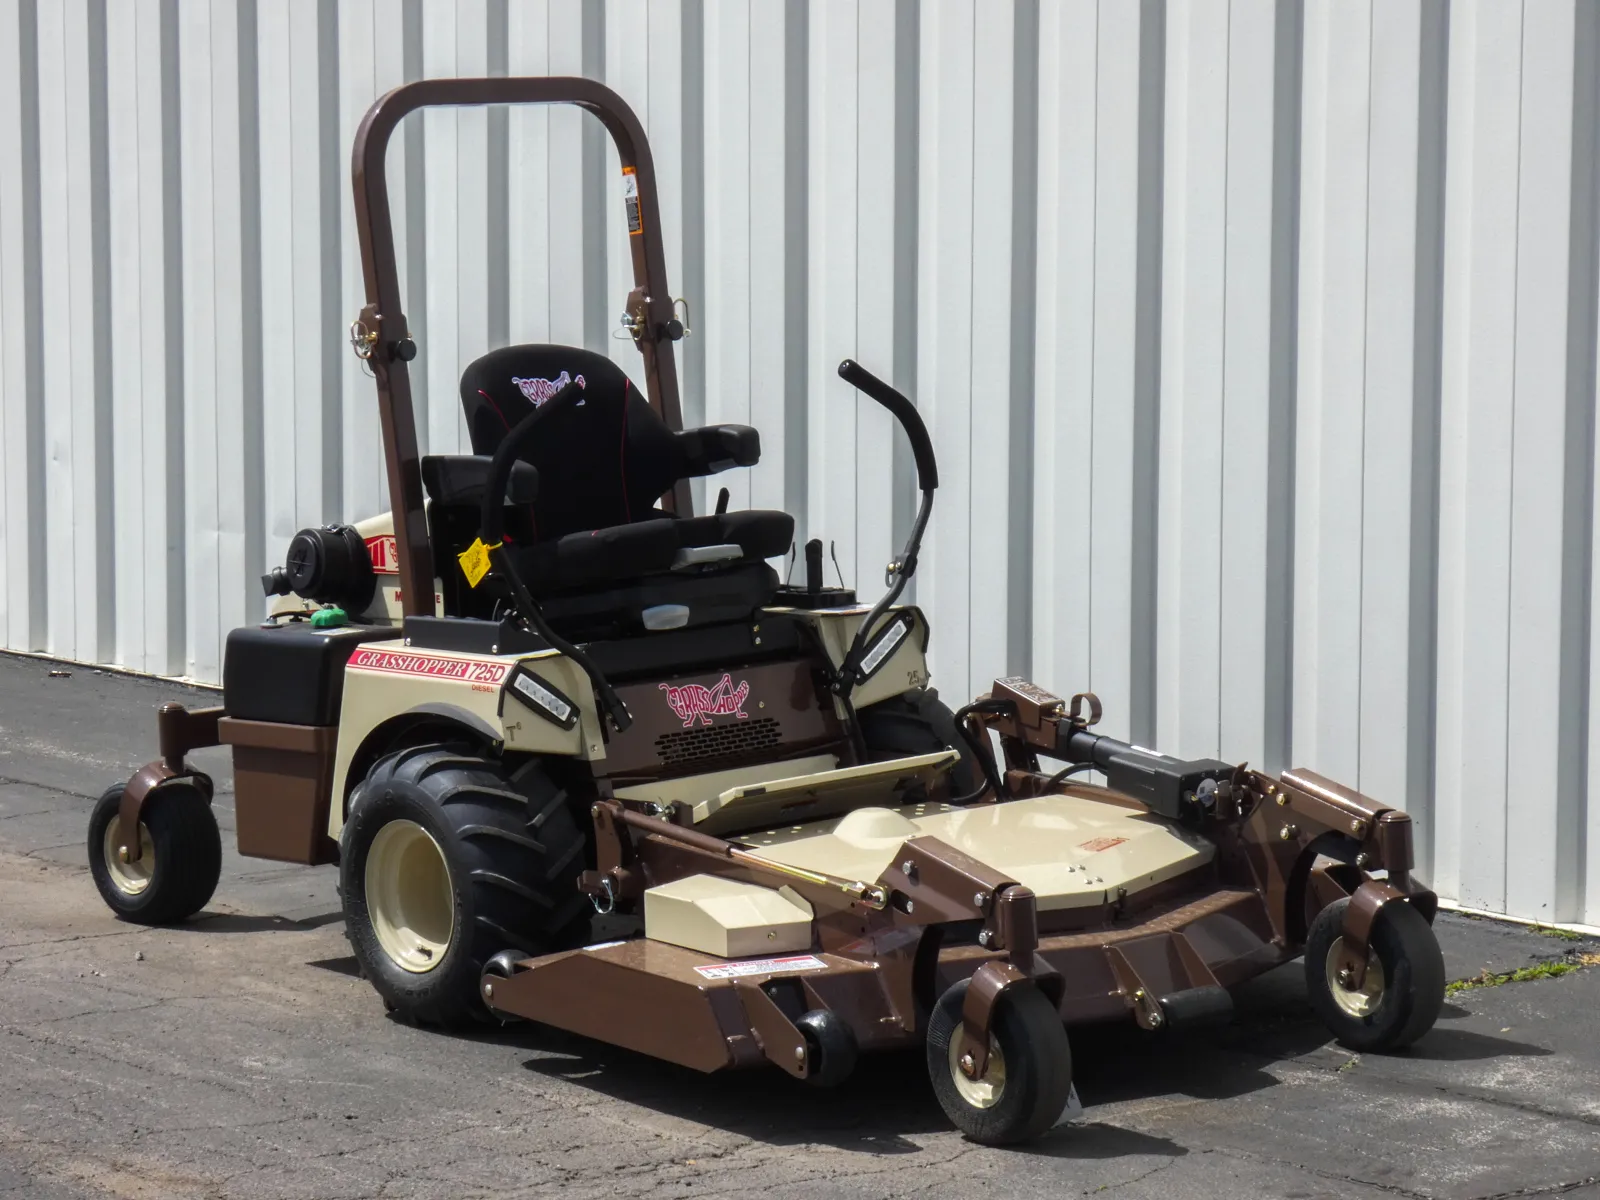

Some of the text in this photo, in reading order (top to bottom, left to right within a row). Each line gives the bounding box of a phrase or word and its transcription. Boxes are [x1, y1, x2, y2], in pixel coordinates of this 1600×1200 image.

[357, 651, 505, 682] GRASSHOPPER 725D
[471, 684, 495, 694] DIESEL
[662, 675, 750, 723] GRASSHOPPER
